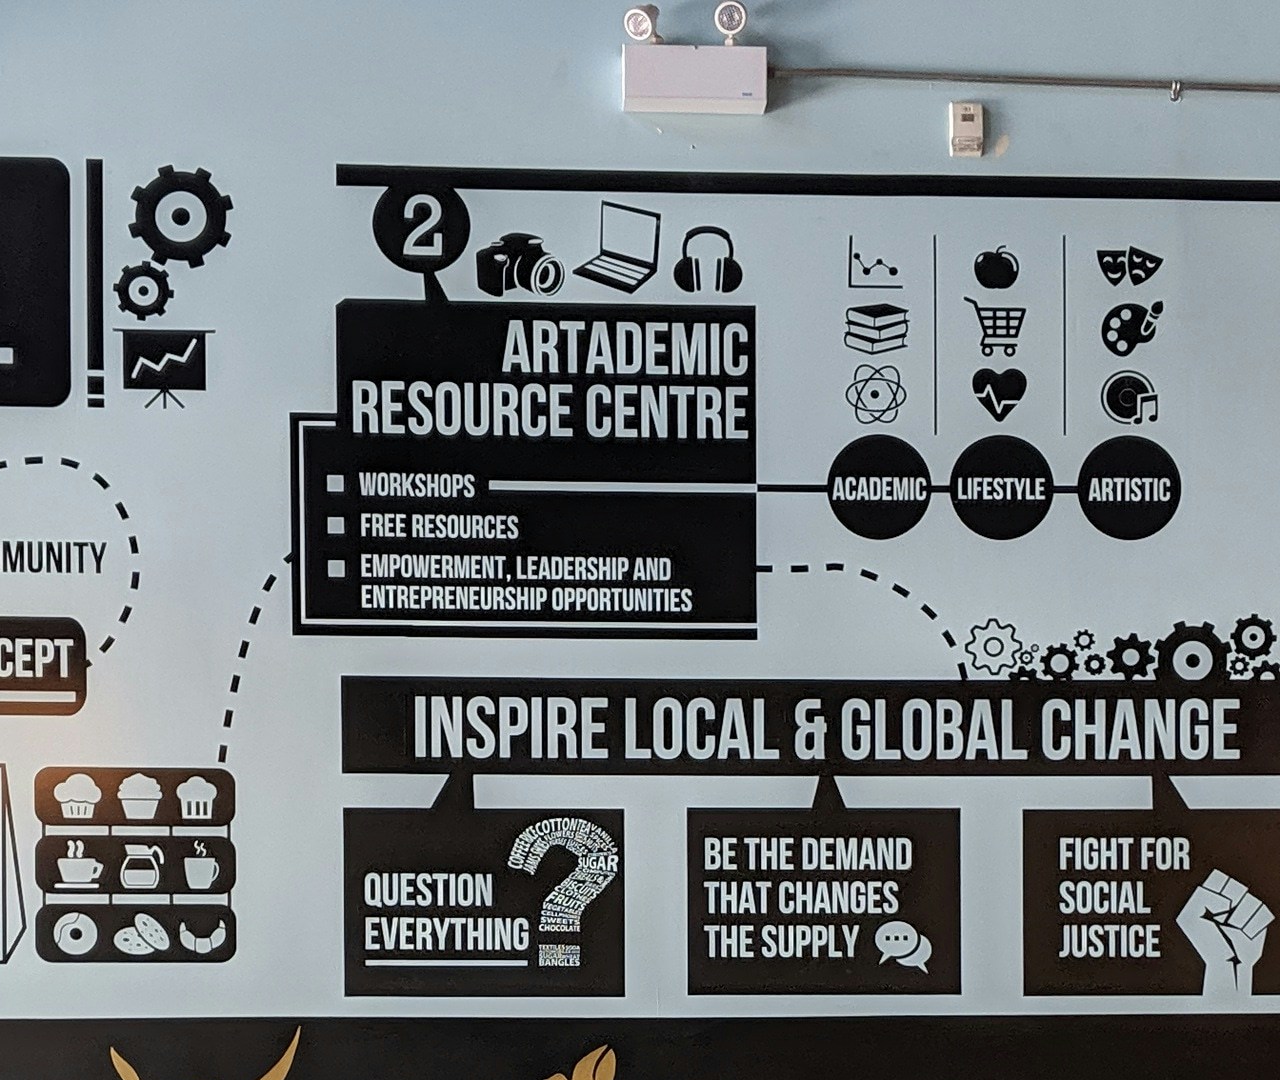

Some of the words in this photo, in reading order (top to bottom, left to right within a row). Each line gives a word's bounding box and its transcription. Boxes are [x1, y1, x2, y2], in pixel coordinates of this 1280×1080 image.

[403, 194, 442, 255] 2
[502, 320, 748, 376] ARTADEMIC
[353, 380, 573, 436] RESOURCE
[587, 384, 748, 439] CENTRE
[359, 472, 475, 497] WORKSHOPS
[833, 477, 926, 500] ACADEMIC
[958, 478, 1045, 500] LIFESTYLE
[1089, 478, 1170, 501] ARTISTIC
[361, 513, 406, 537] FREE
[412, 514, 518, 539] RESOURCES
[361, 554, 511, 582] EMPOWERMENT,
[517, 556, 629, 580] LEADERSHIP
[633, 558, 671, 580] AND
[362, 585, 547, 610] ENTREPRENEURSHIP
[552, 588, 692, 611] OPPORTUNITIES
[415, 696, 608, 758] INSPIRE
[625, 697, 779, 759] LOCAL
[795, 699, 827, 760] &
[842, 698, 1027, 760] GLOBAL
[1042, 698, 1240, 760] CHANGE
[535, 817, 577, 836] COTTON
[578, 855, 619, 872] SUGAR
[705, 838, 737, 870] BE
[744, 838, 794, 870] THE
[802, 838, 912, 870] DEMAND
[1060, 837, 1133, 870] FIGHT
[1141, 837, 1189, 870] FOR
[365, 873, 492, 907] QUESTION
[544, 891, 587, 911] FRUITS
[704, 882, 771, 913] THAT
[779, 881, 898, 913] CHANGES
[1060, 881, 1150, 913] SOCIAL
[365, 917, 529, 950] EVERYTHING
[539, 924, 580, 932] CHOCOLATE
[541, 917, 580, 925] SWEETS
[704, 925, 754, 957] THE
[762, 925, 859, 957] SUPPLY
[1059, 925, 1160, 957] JUSTICE
